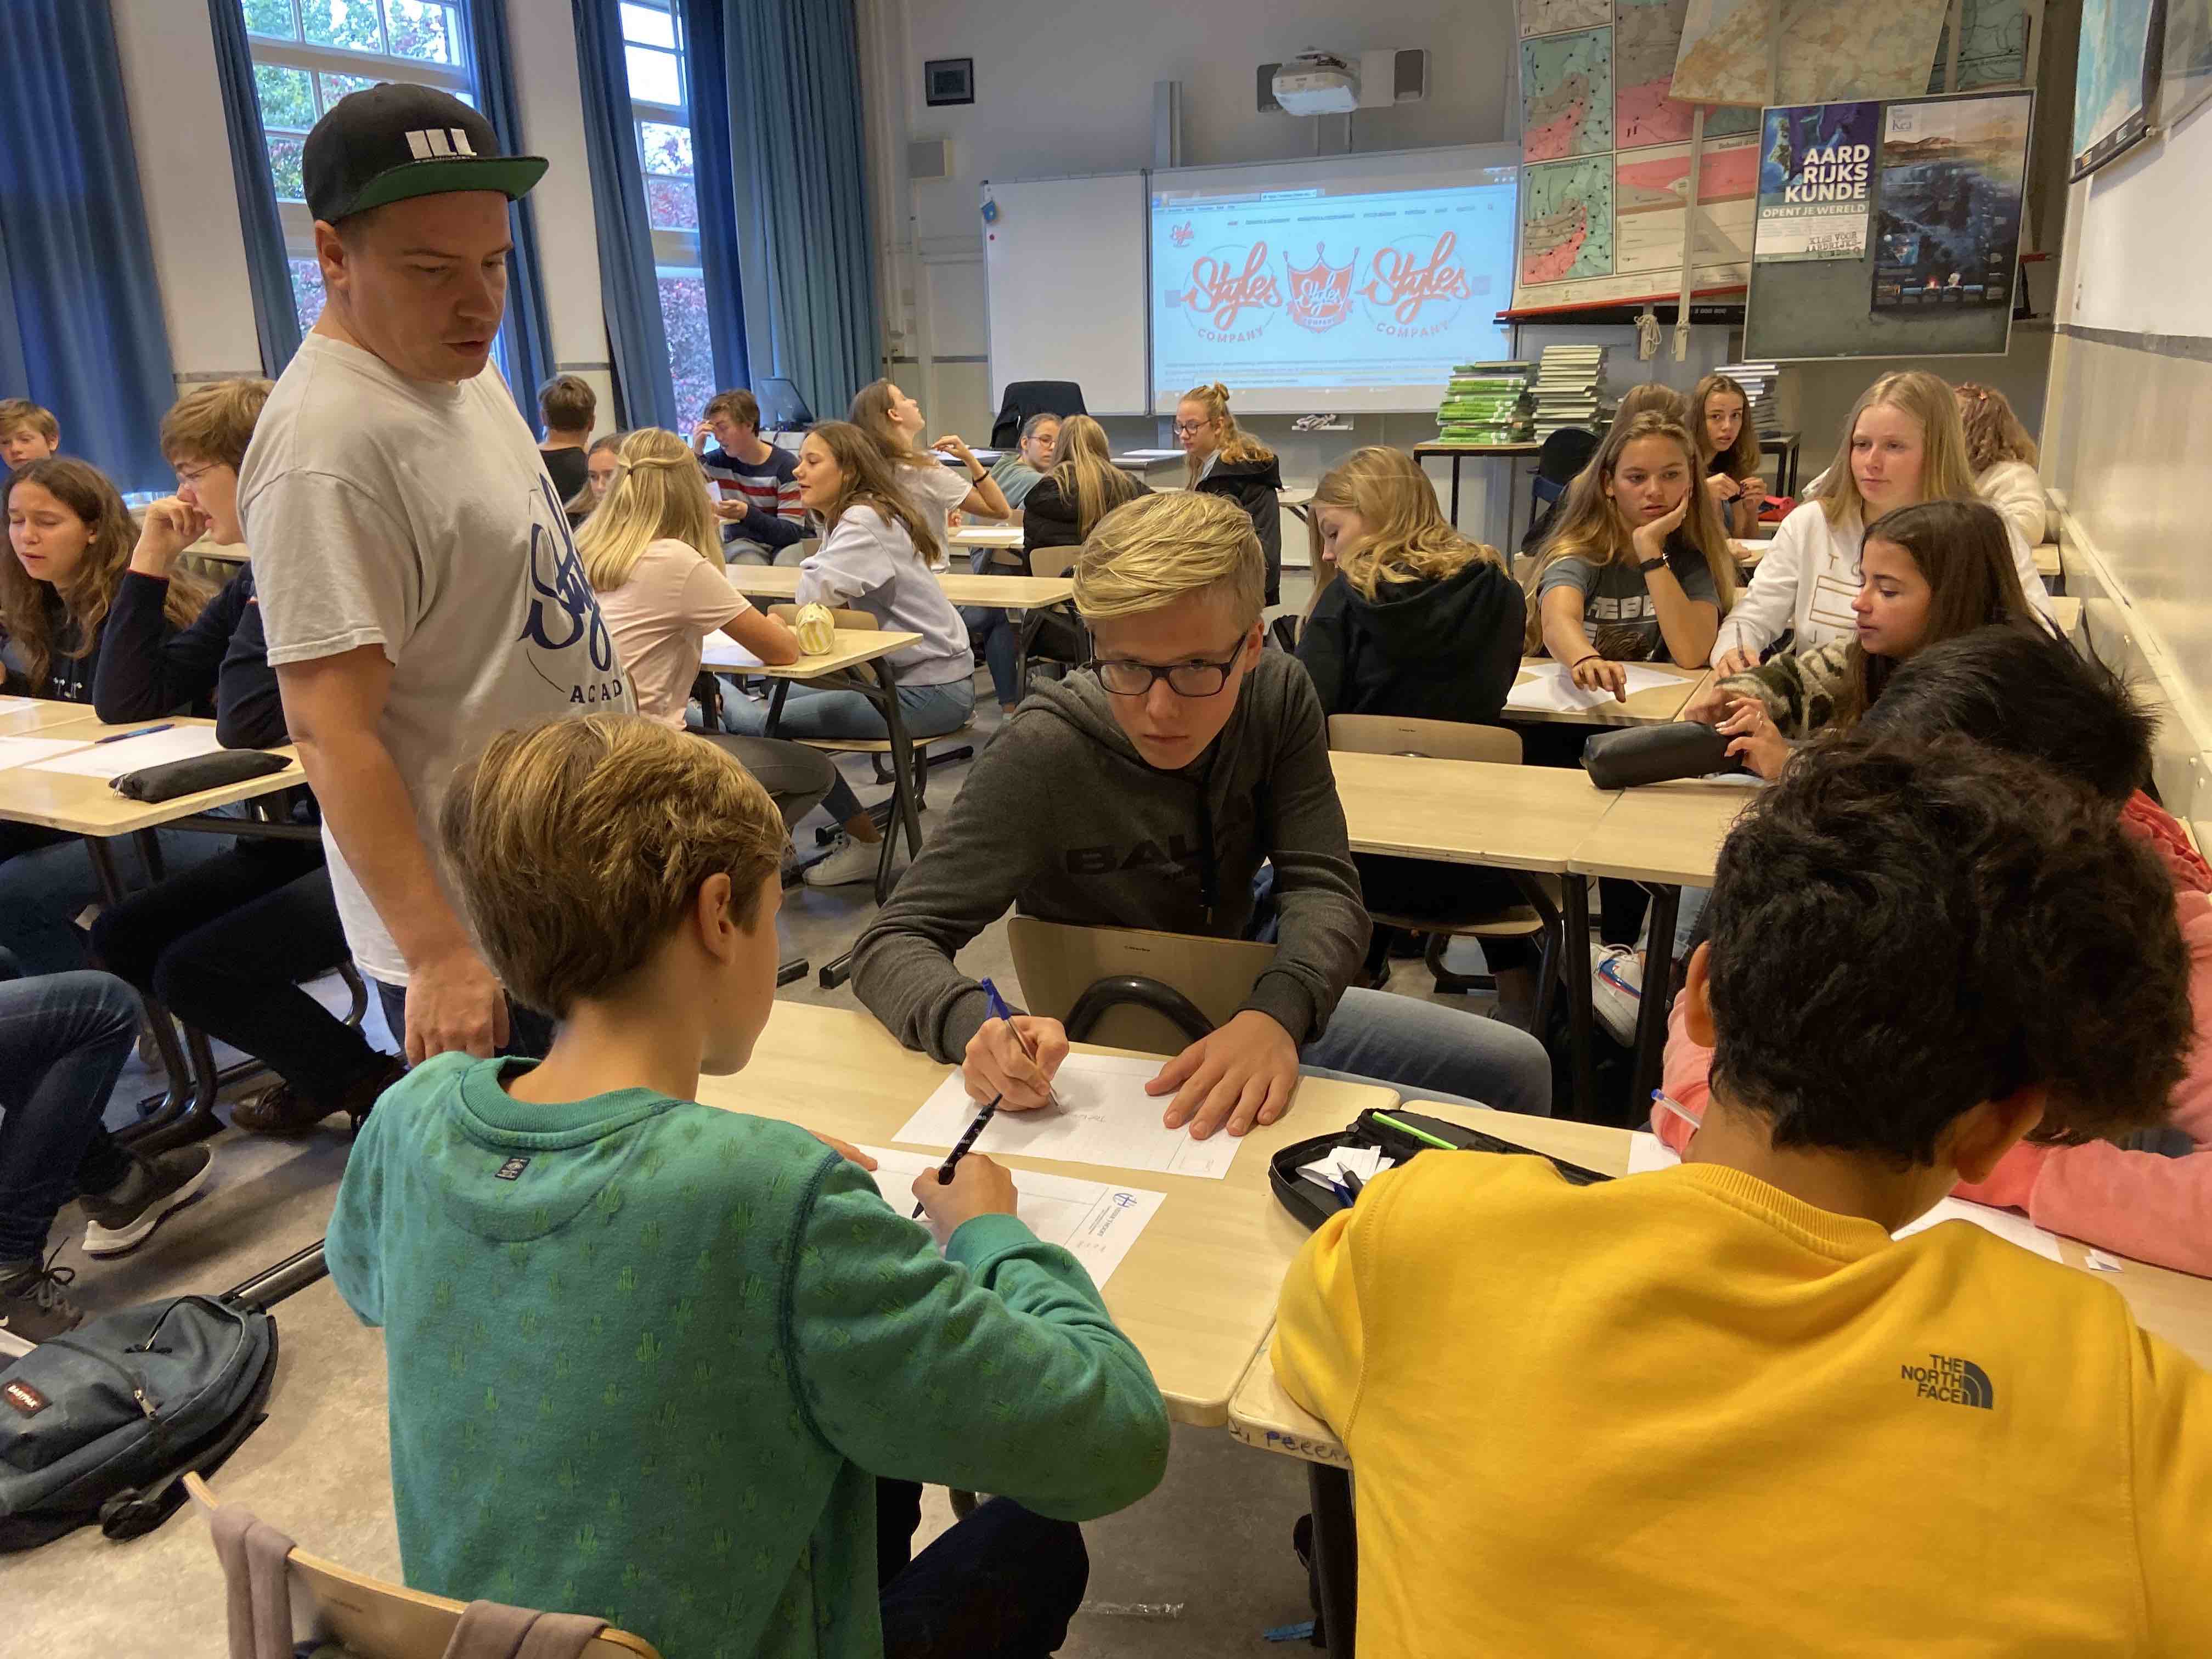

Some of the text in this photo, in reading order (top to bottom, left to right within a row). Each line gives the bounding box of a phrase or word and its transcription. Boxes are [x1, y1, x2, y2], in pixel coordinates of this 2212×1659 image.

[1804, 144, 1870, 165] AARD
[1803, 163, 1869, 183] RIJKS
[1784, 182, 1867, 203] KUNDE
[1763, 204, 1865, 217] OPENT JE WERELD
[1181, 241, 1283, 330] Styles
[1355, 231, 1471, 325] Styles
[1295, 272, 1342, 316] Styles
[1198, 328, 1263, 343] COMPANY
[1376, 321, 1449, 337] COMPANY
[570, 679, 623, 704] ACAD
[1066, 834, 1203, 874] BAL
[1929, 1353, 1963, 1374] THE
[1900, 1364, 1962, 1389] NORTH
[1917, 1383, 1961, 1404] FACE
